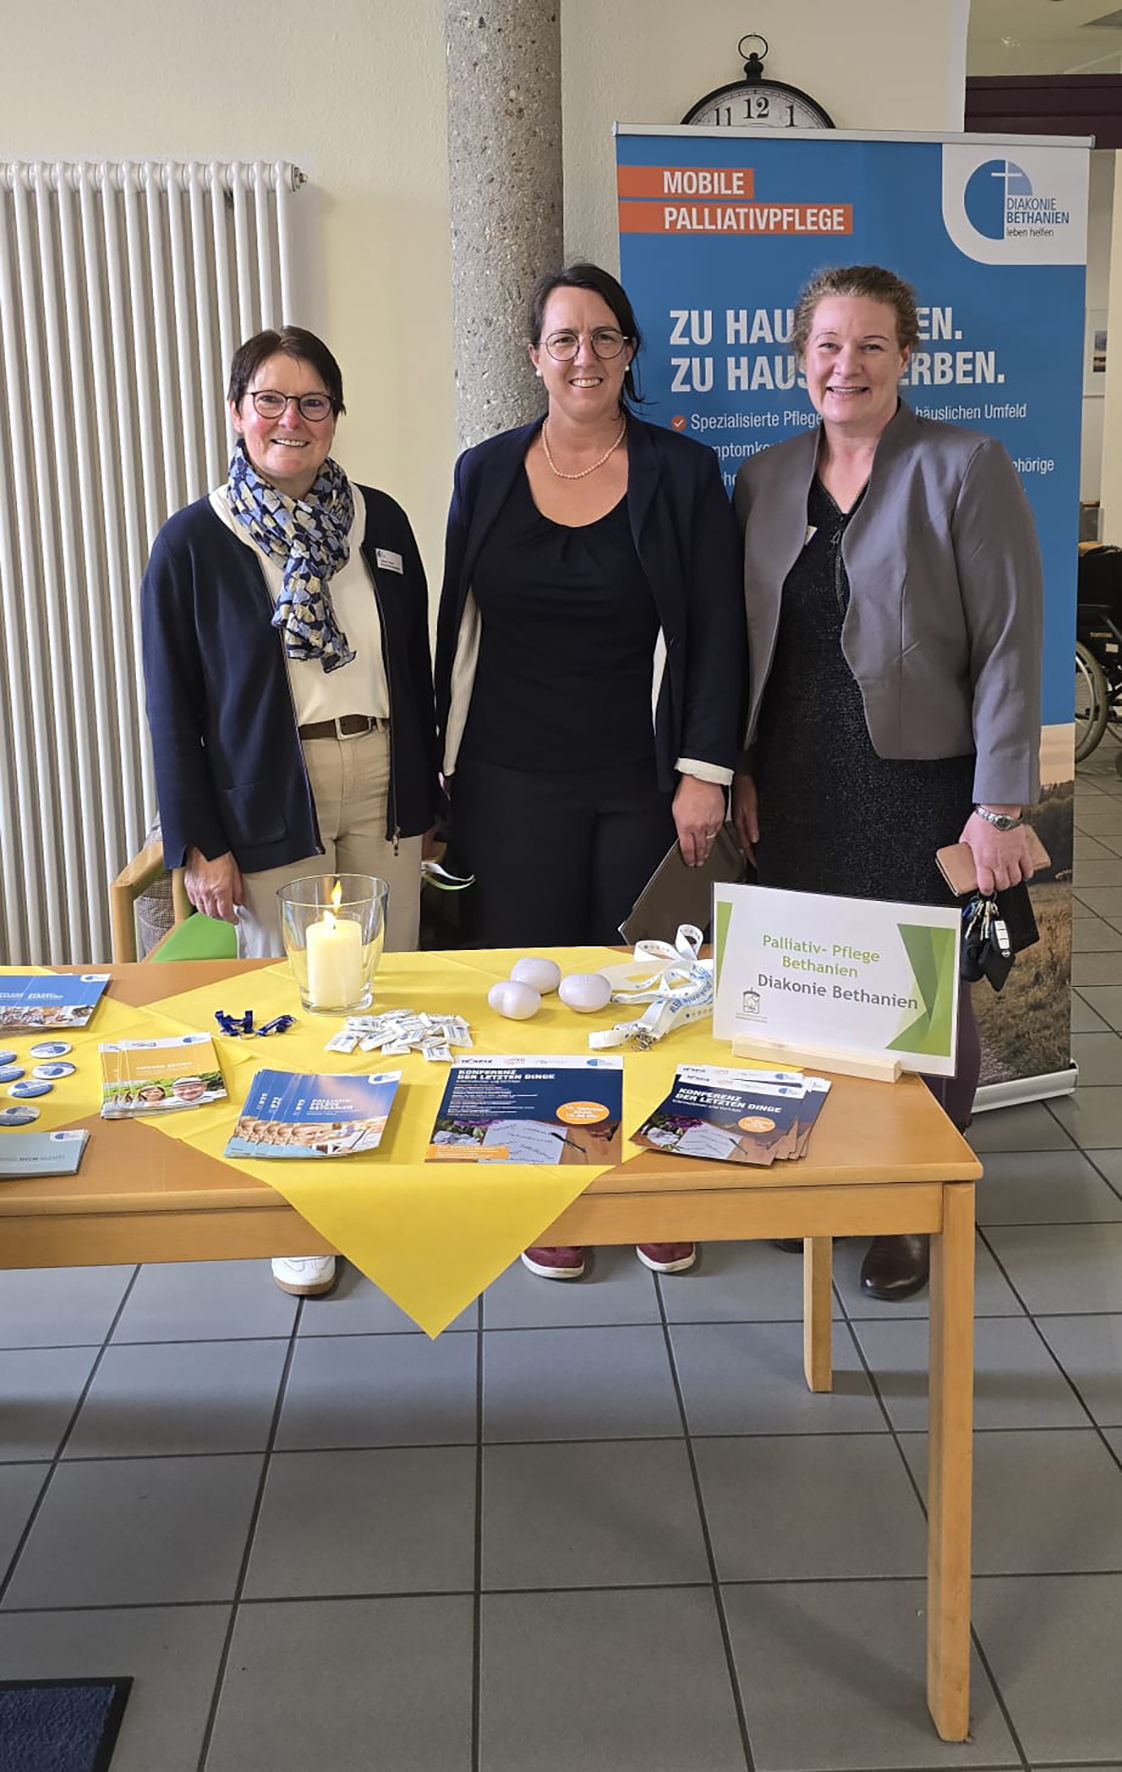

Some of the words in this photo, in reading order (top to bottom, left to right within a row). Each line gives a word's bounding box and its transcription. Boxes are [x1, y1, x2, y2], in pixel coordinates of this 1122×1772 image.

[742, 96, 770, 118] 12
[785, 104, 797, 127] 1
[662, 171, 745, 194] MOBILE
[1007, 198, 1057, 211] DIAKONIE
[664, 207, 845, 231] PALLIATIVPFLEGE
[1007, 212, 1069, 224] BETHANIEN
[1007, 228, 1028, 237] leben
[669, 310, 713, 346] ZU
[726, 309, 796, 344] HAU
[671, 357, 714, 393] ZU
[690, 411, 780, 432] Spezialisierte
[783, 410, 822, 428] Pflege
[915, 404, 981, 421] häuslichen
[984, 403, 1027, 419] Umfeld
[762, 934, 827, 954] Palliativ-
[832, 944, 881, 964] Pflege
[782, 955, 858, 978] Bethanien
[757, 973, 827, 997] Diakonie
[832, 985, 919, 1010] Bethanien
[678, 1087, 743, 1102] KONFERENZ
[699, 1096, 746, 1109] LETZTEN
[748, 1103, 783, 1114] DINGE
